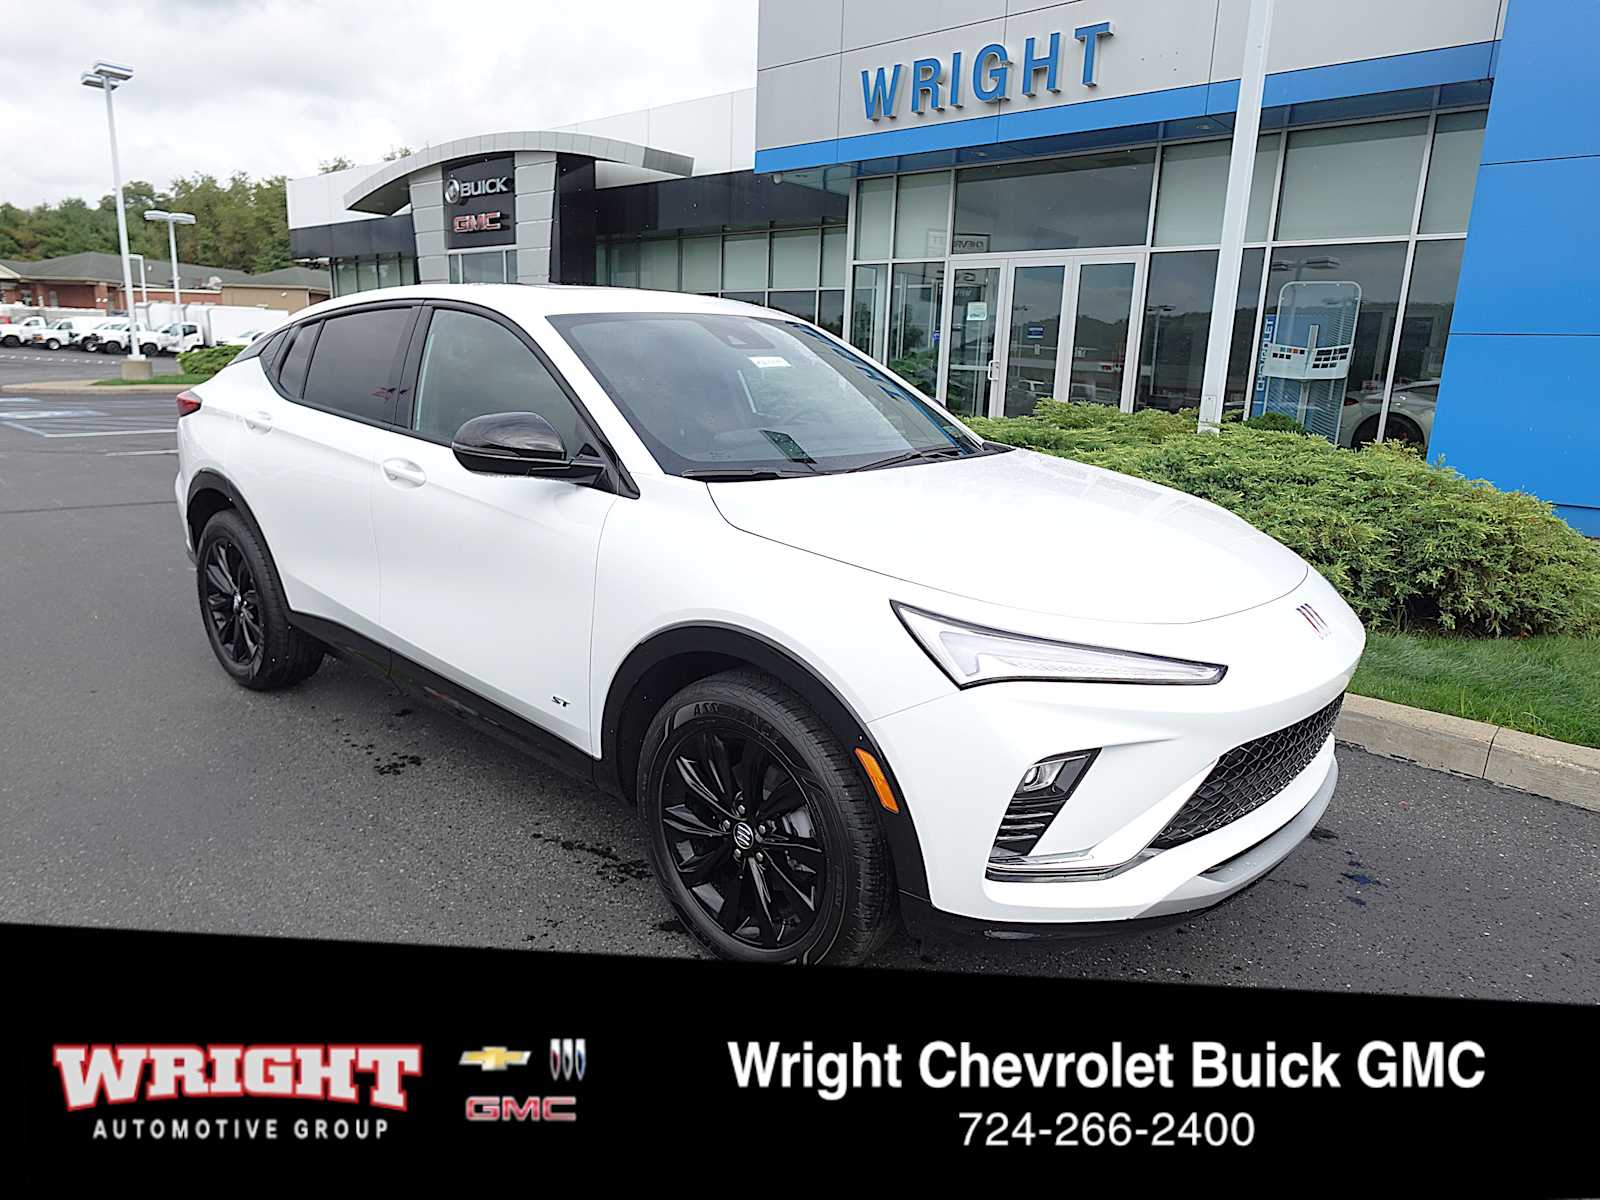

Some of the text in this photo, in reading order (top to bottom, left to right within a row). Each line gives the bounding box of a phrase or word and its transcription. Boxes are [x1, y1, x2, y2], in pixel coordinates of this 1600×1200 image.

[861, 21, 1114, 122] WRIGHT
[460, 176, 509, 198] BUICK
[453, 211, 501, 233] GMC
